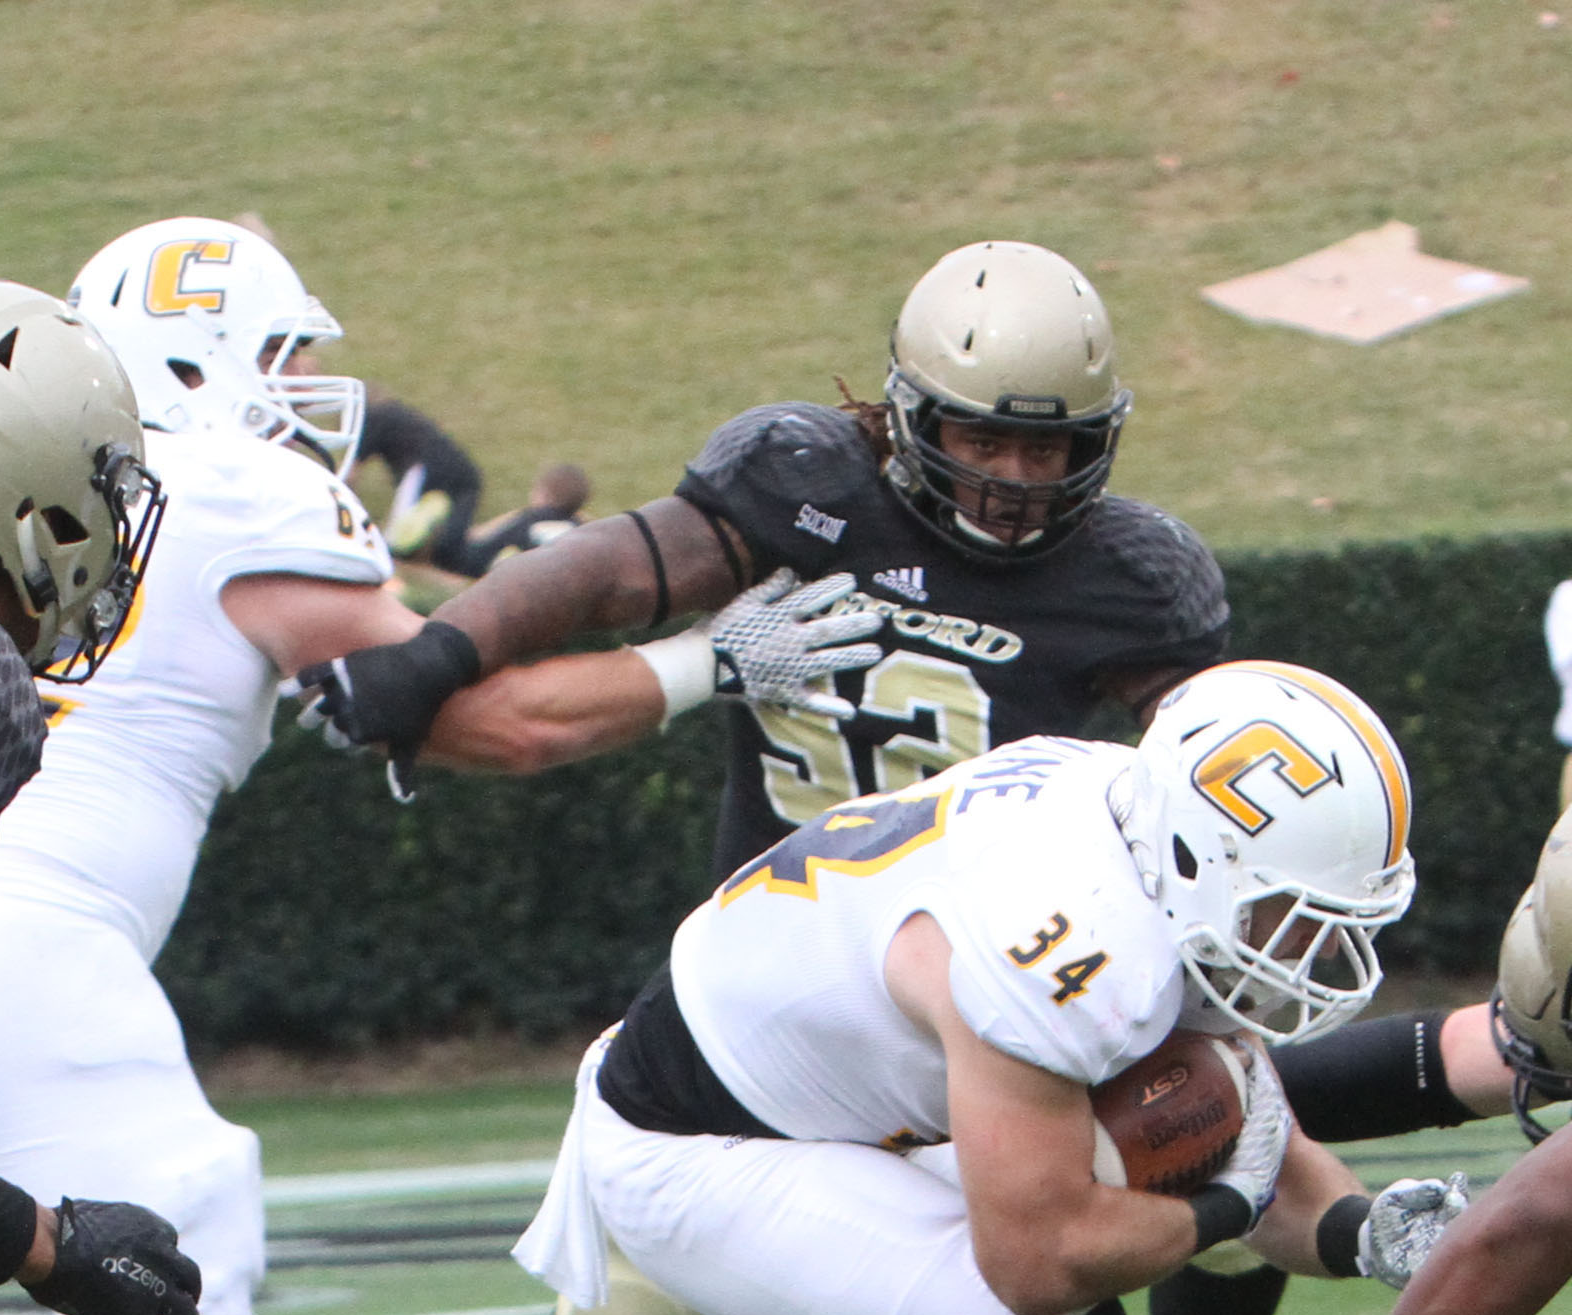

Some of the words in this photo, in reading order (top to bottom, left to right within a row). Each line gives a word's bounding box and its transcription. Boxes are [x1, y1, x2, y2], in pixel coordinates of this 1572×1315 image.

[144, 239, 234, 318] C
[1191, 719, 1336, 837] C
[1006, 912, 1112, 1008] 34
